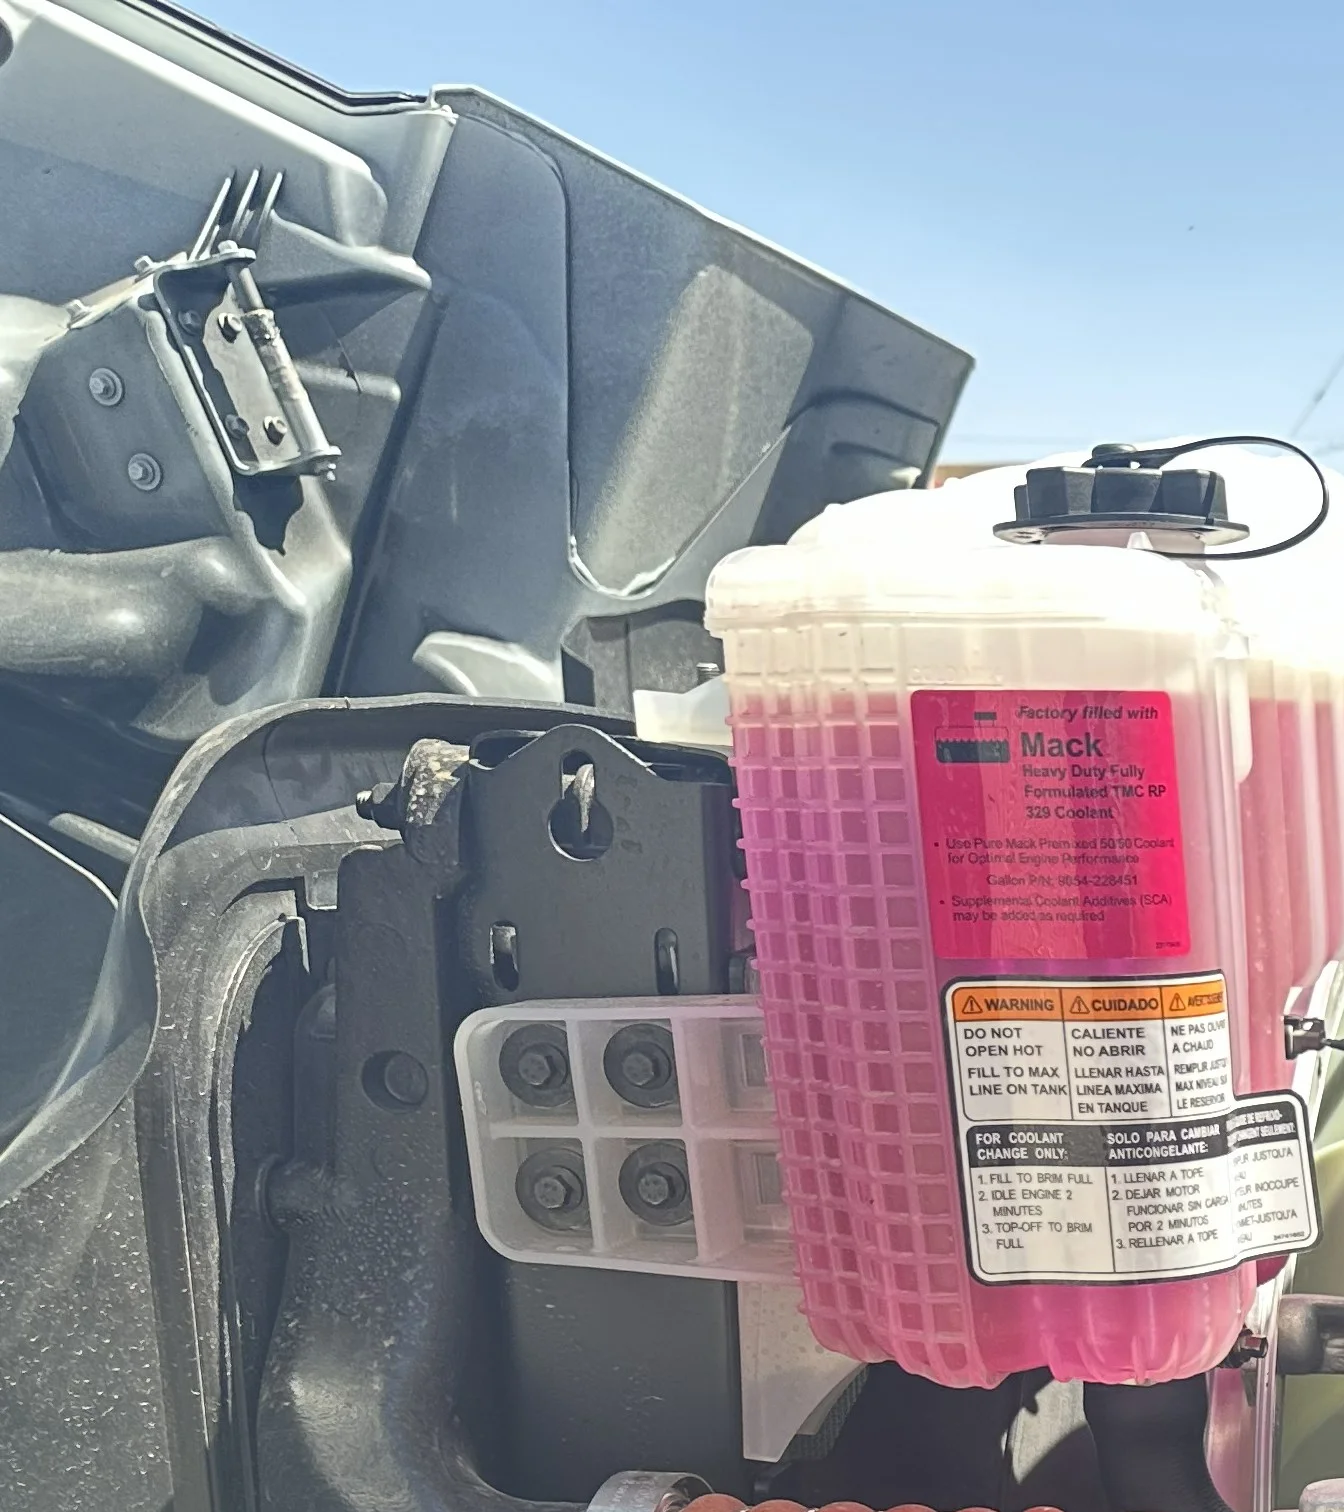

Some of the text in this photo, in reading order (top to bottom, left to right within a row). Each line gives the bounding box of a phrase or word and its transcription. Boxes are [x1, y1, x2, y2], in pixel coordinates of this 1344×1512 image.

[1017, 705, 1157, 722] Factory filled with
[1021, 731, 1104, 757] Mack
[1022, 764, 1145, 780] Heavy Duty Fully
[1024, 784, 1166, 799] Formulated TMC RP
[1026, 806, 1114, 820] 329 Coolant
[984, 997, 1054, 1011] WARNING
[1092, 997, 1158, 1011] CUIDADO
[964, 1027, 1021, 1039] DO NOT
[1071, 1027, 1144, 1039] CALIENTE
[1170, 1022, 1205, 1036] NE PAS
[965, 1044, 1042, 1056] OPEN HOT
[1073, 1044, 1144, 1056] NO ABRIR
[967, 1066, 1059, 1078] FILL TO MAX
[1074, 1065, 1164, 1078] LLENAR HASTA
[969, 1083, 1067, 1095] LINE ON TANK
[1076, 1082, 1162, 1096] LINEA MAXIMA
[1078, 1101, 1147, 1113] EN TANQUE
[1176, 1098, 1188, 1109] LE
[975, 1131, 1063, 1144] FOR COOLANT
[1106, 1131, 1140, 1144] SOLO
[1146, 1130, 1177, 1142] PARA
[1181, 1124, 1220, 1140] CAMBIAR
[977, 1147, 1028, 1160] CHANGE
[989, 1172, 1092, 1184] FILL TO BRIM FULL
[1123, 1167, 1202, 1184] LLENAR A TOPE
[991, 1189, 1072, 1200] IDLE ENGINE 2
[1125, 1184, 1199, 1200] DEJAR MOTOR
[992, 1205, 1042, 1216] MINUTES
[1126, 1200, 1201, 1217] FUNCIONAR SIN
[994, 1222, 1092, 1232] TOP-OFF TO BRIM
[1128, 1215, 1207, 1232] POR 2 MINUTOS
[996, 1237, 1023, 1249] FULL
[1128, 1229, 1217, 1249] RELLENAR A TOPE
